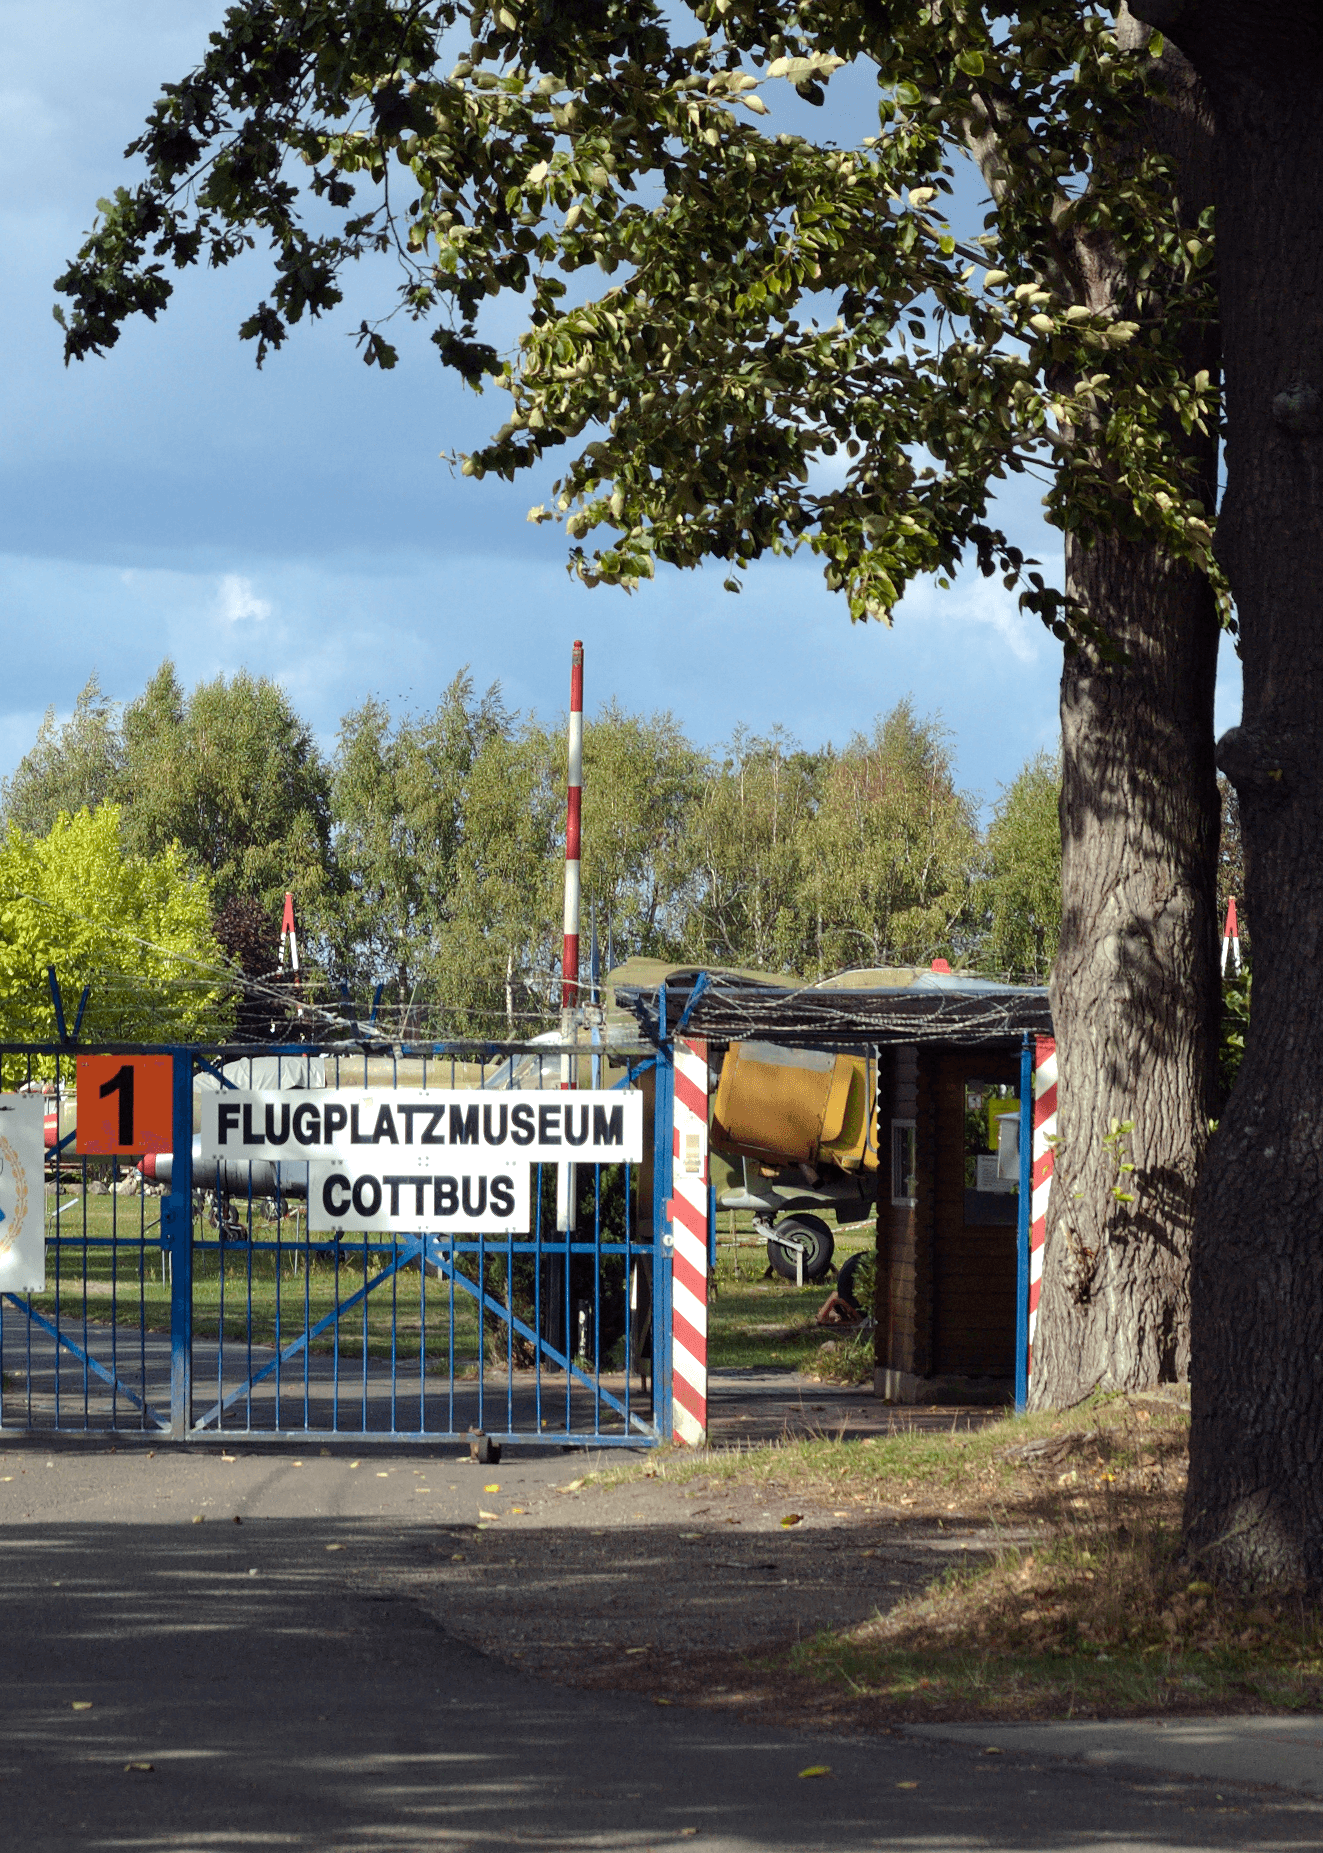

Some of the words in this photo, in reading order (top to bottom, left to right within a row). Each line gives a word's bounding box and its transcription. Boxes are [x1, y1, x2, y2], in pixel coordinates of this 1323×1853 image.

[99, 1064, 135, 1146] 1
[217, 1102, 625, 1147] FLUGPLATZMUSEUM
[321, 1173, 516, 1218] COTTBUS
